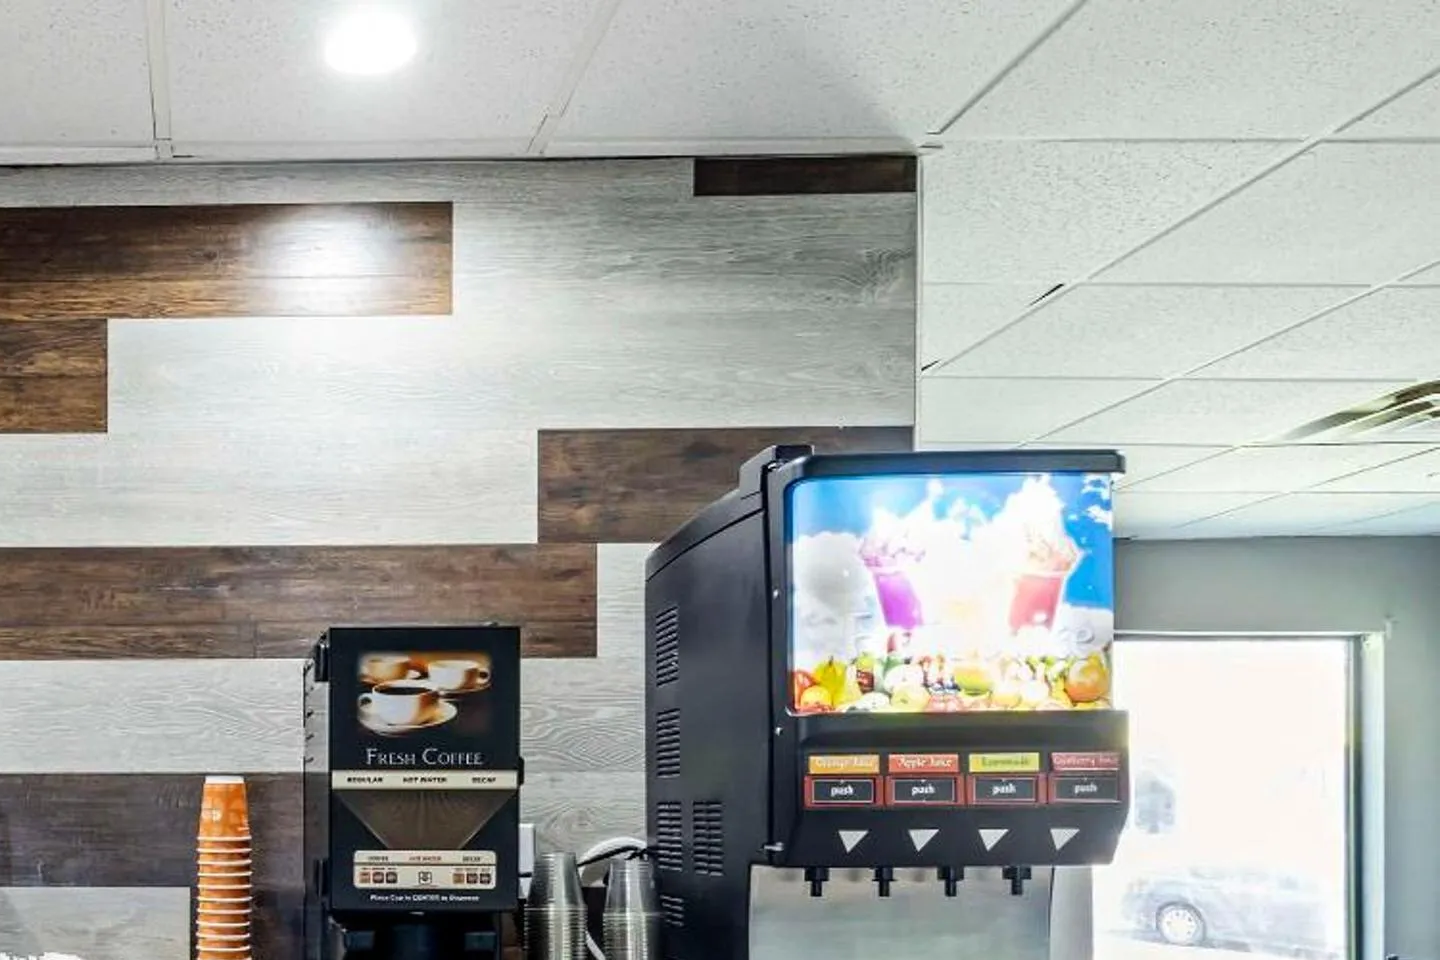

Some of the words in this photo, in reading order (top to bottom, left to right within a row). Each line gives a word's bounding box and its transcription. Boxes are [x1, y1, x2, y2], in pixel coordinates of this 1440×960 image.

[366, 748, 416, 765] FRESH
[422, 747, 484, 765] COFFEE
[896, 756, 927, 770] Apple
[830, 784, 855, 798] push
[911, 784, 936, 797] push
[992, 782, 1017, 796] push
[1074, 782, 1098, 794] push
